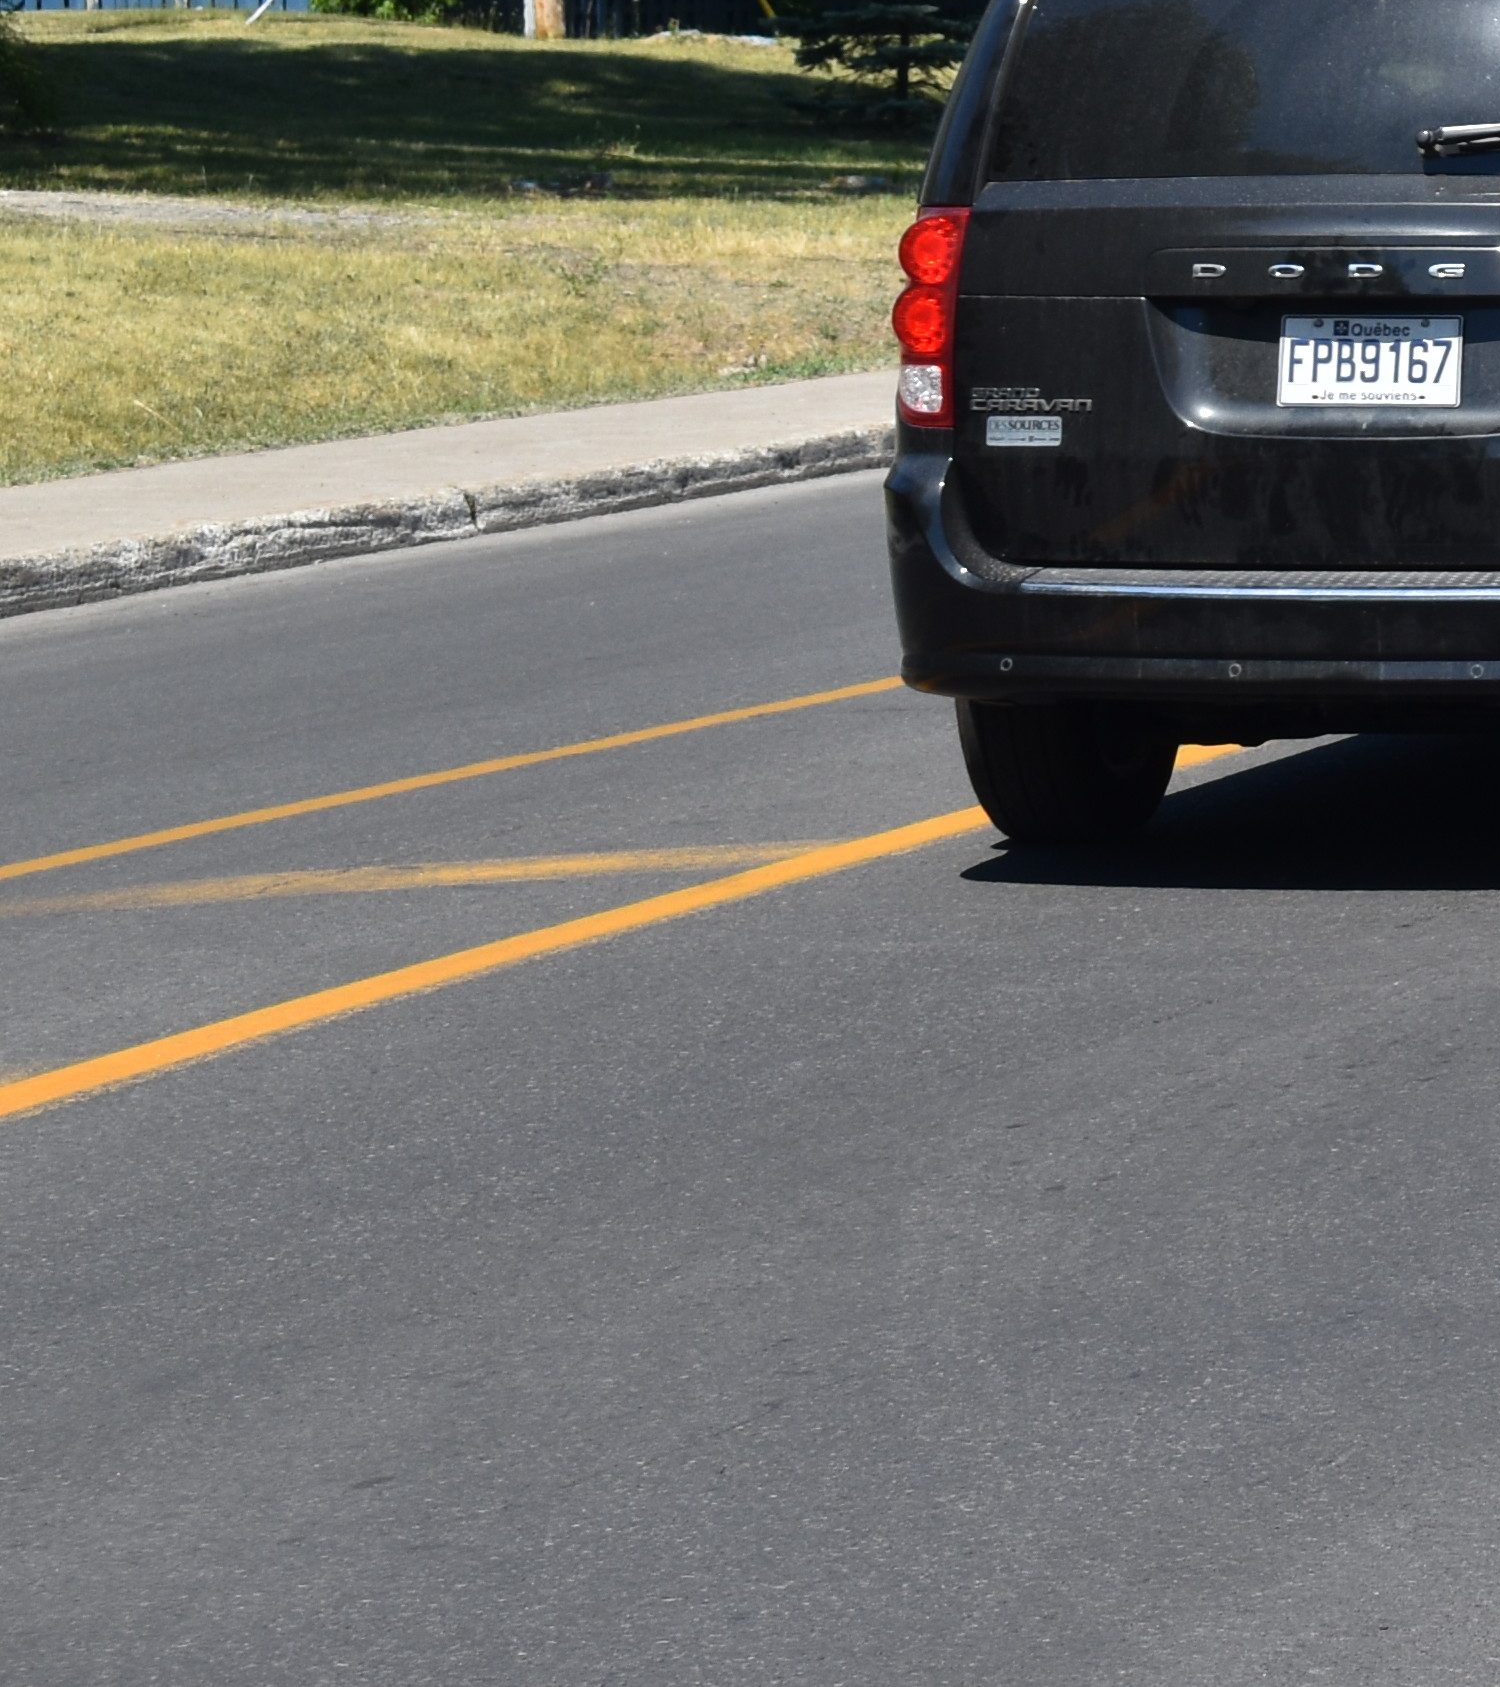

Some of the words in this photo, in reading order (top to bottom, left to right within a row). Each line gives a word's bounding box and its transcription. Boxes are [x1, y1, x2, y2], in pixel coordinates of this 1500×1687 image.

[1351, 322, 1411, 337] Québec
[1288, 339, 1453, 384] FPB9167
[1319, 390, 1334, 401] Je
[1338, 392, 1356, 401] me
[1361, 391, 1417, 401] souviens
[970, 398, 1093, 411] CARAVAN
